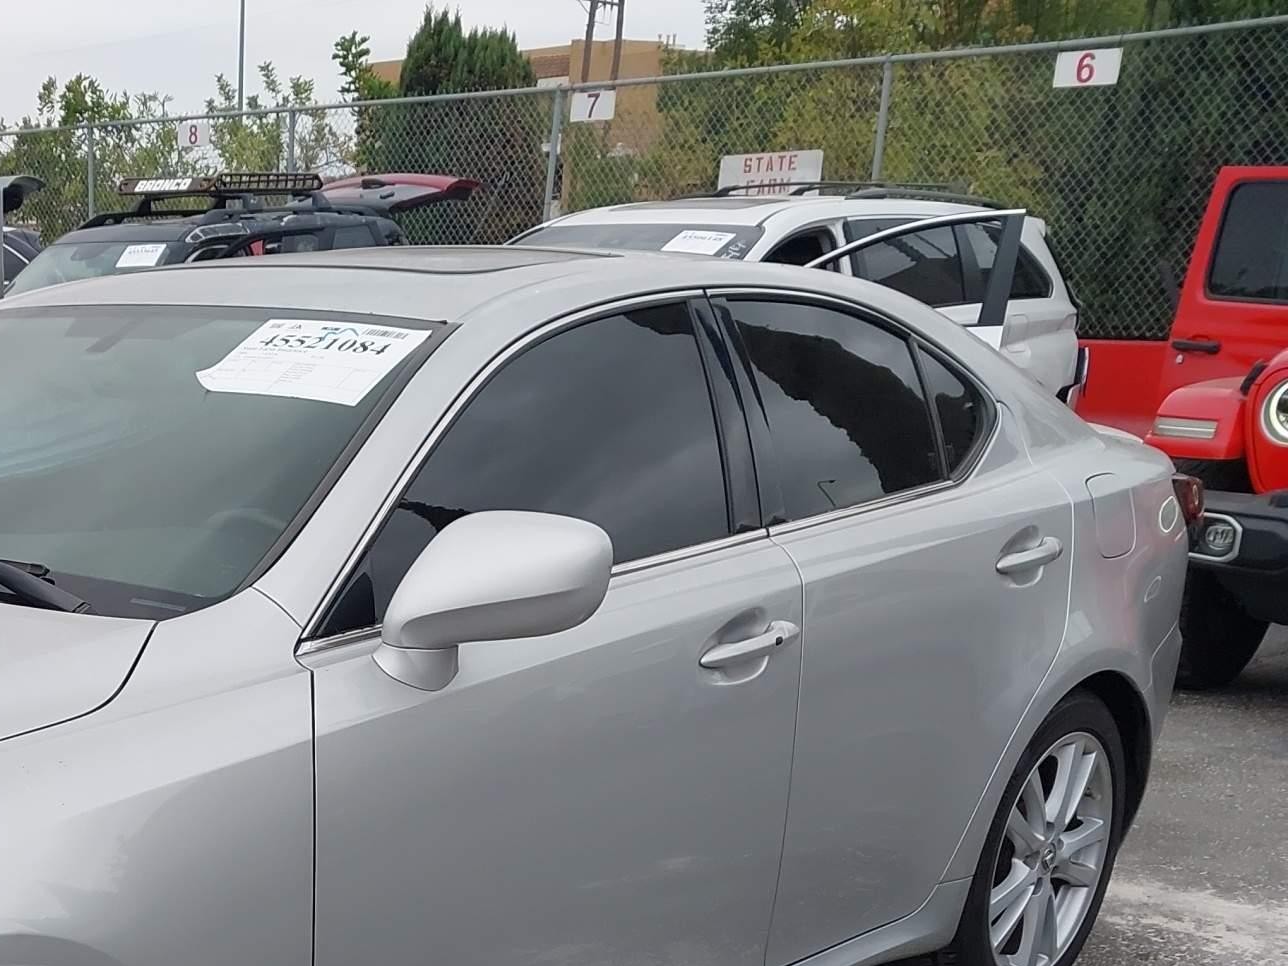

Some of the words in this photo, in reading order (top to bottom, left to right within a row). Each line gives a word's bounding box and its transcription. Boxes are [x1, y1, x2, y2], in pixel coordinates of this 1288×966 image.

[1077, 52, 1096, 83] 6
[587, 92, 601, 119] 7
[189, 124, 198, 145] 8
[743, 154, 798, 174] STATE
[133, 178, 193, 192] BRONCO
[745, 177, 792, 197] FARM
[260, 334, 392, 355] 45521084
